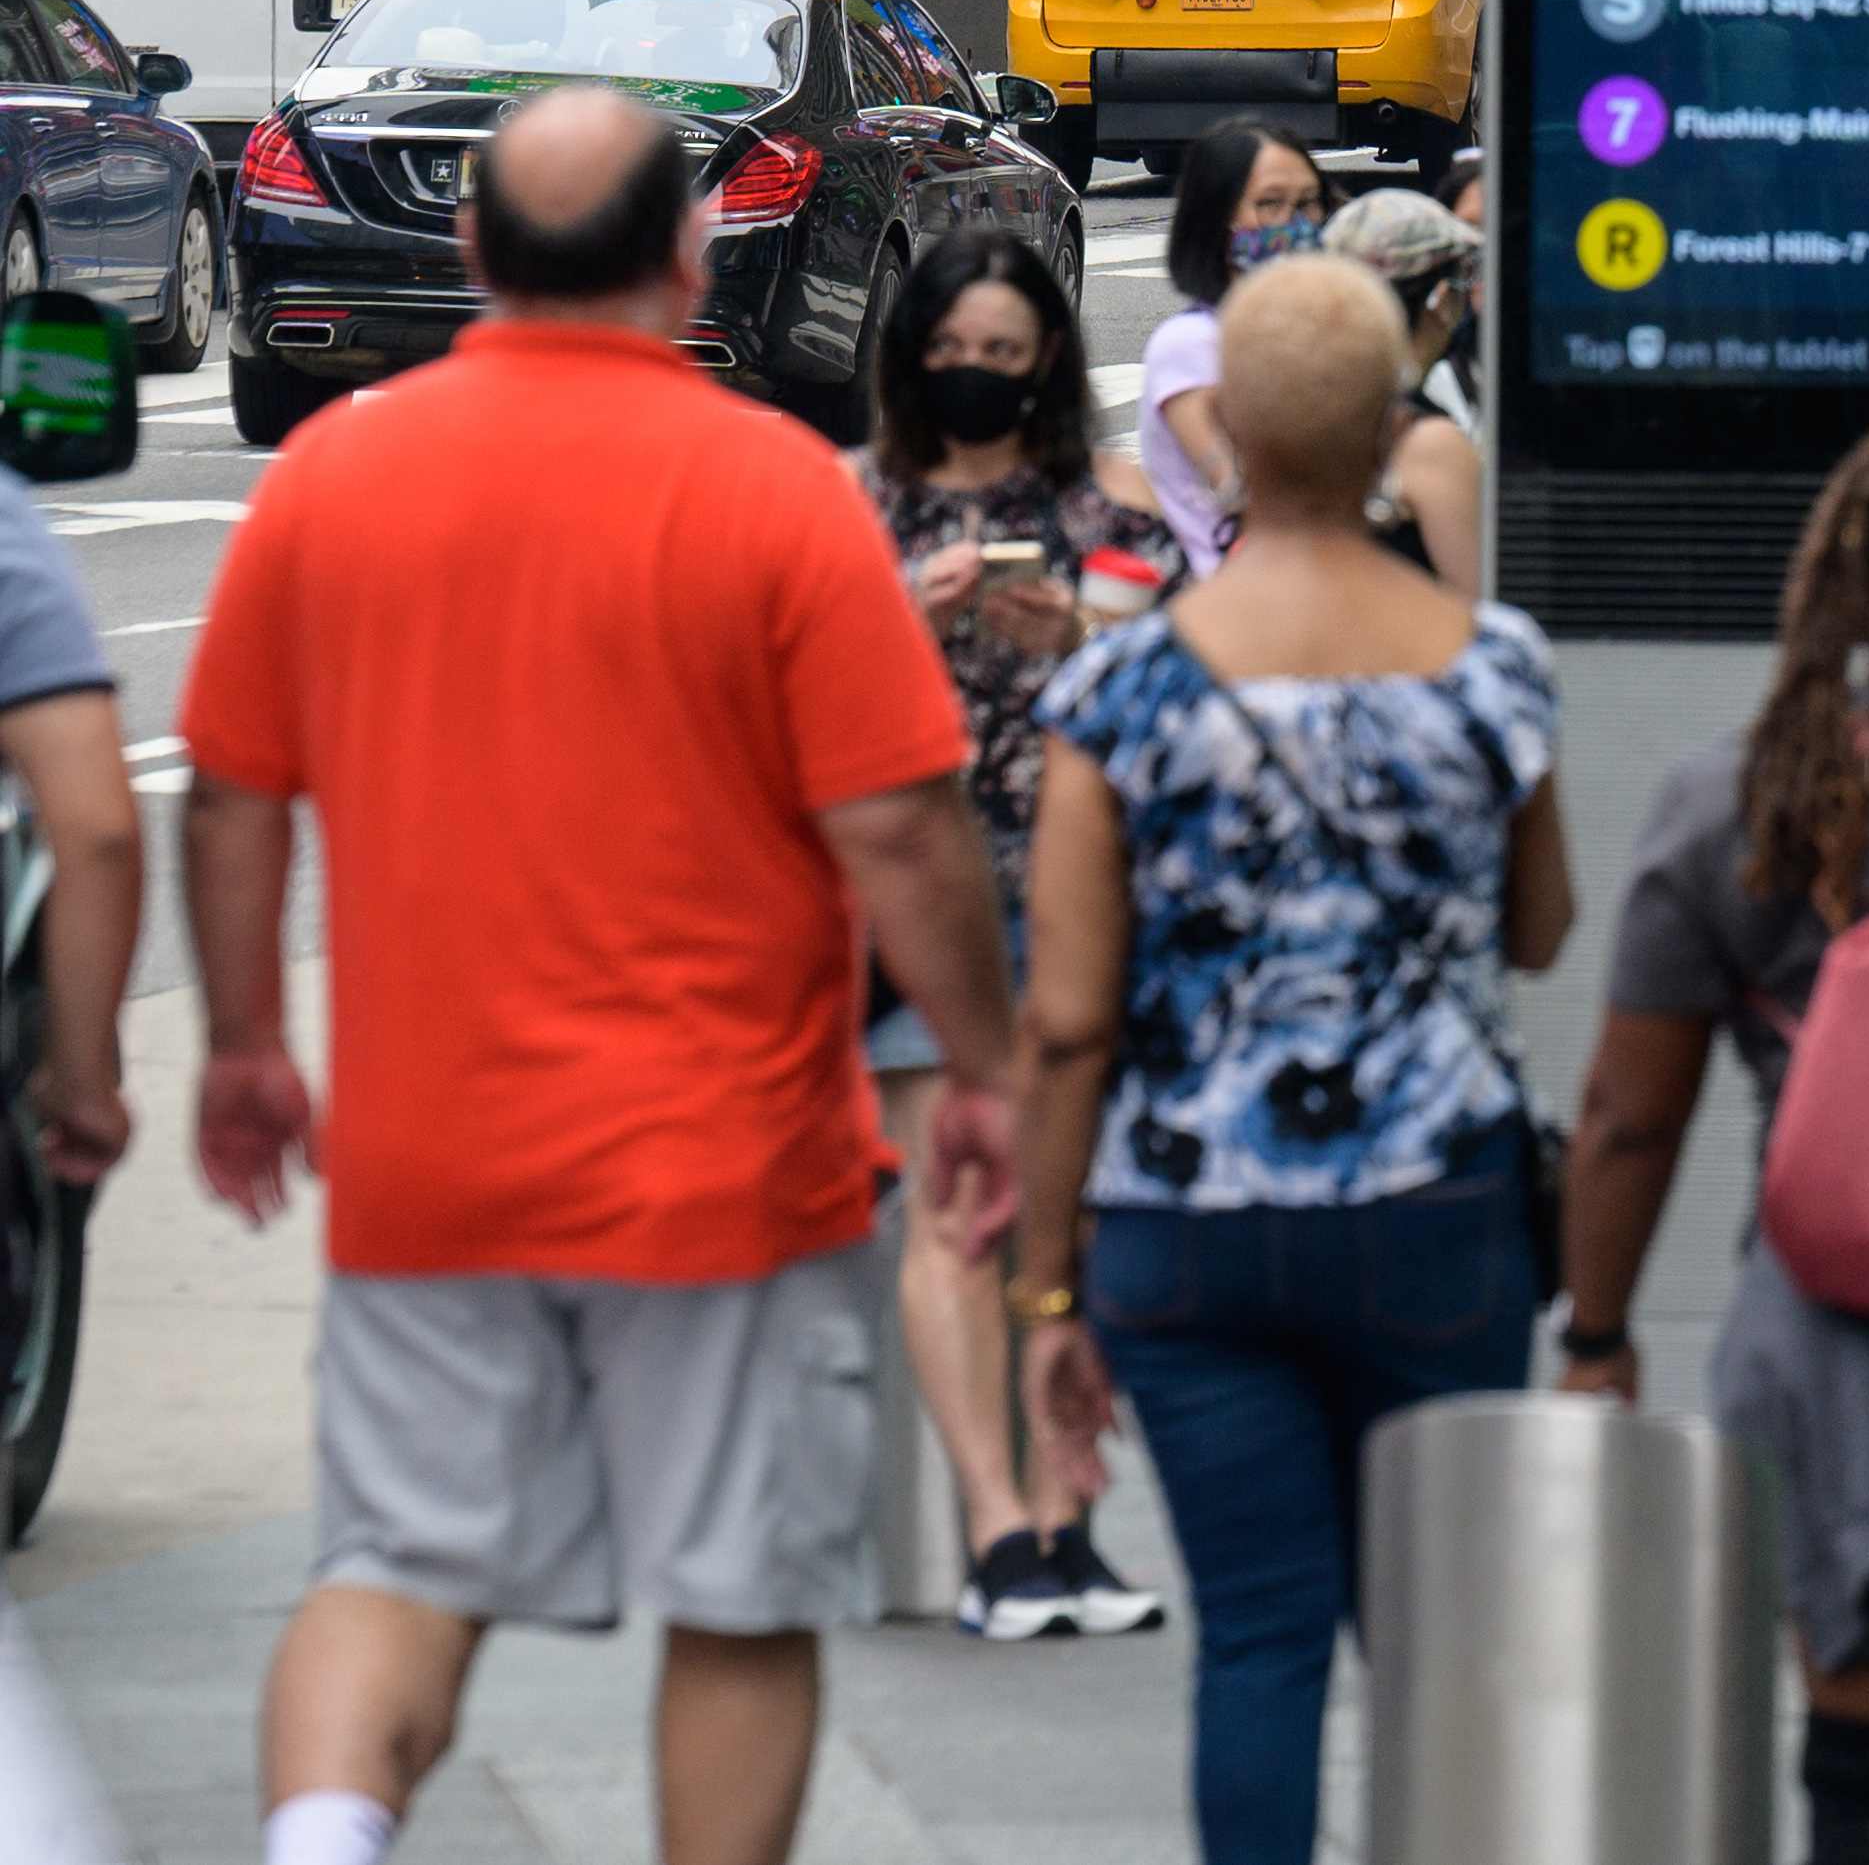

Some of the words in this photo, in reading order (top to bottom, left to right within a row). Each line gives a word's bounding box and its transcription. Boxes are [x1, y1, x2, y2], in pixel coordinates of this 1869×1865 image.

[1608, 100, 1640, 146] 7
[1605, 224, 1638, 268] R
[1674, 232, 1768, 264] Forest
[1566, 340, 1622, 376] Tap
[1667, 344, 1711, 368] on
[1717, 340, 1771, 369] the
